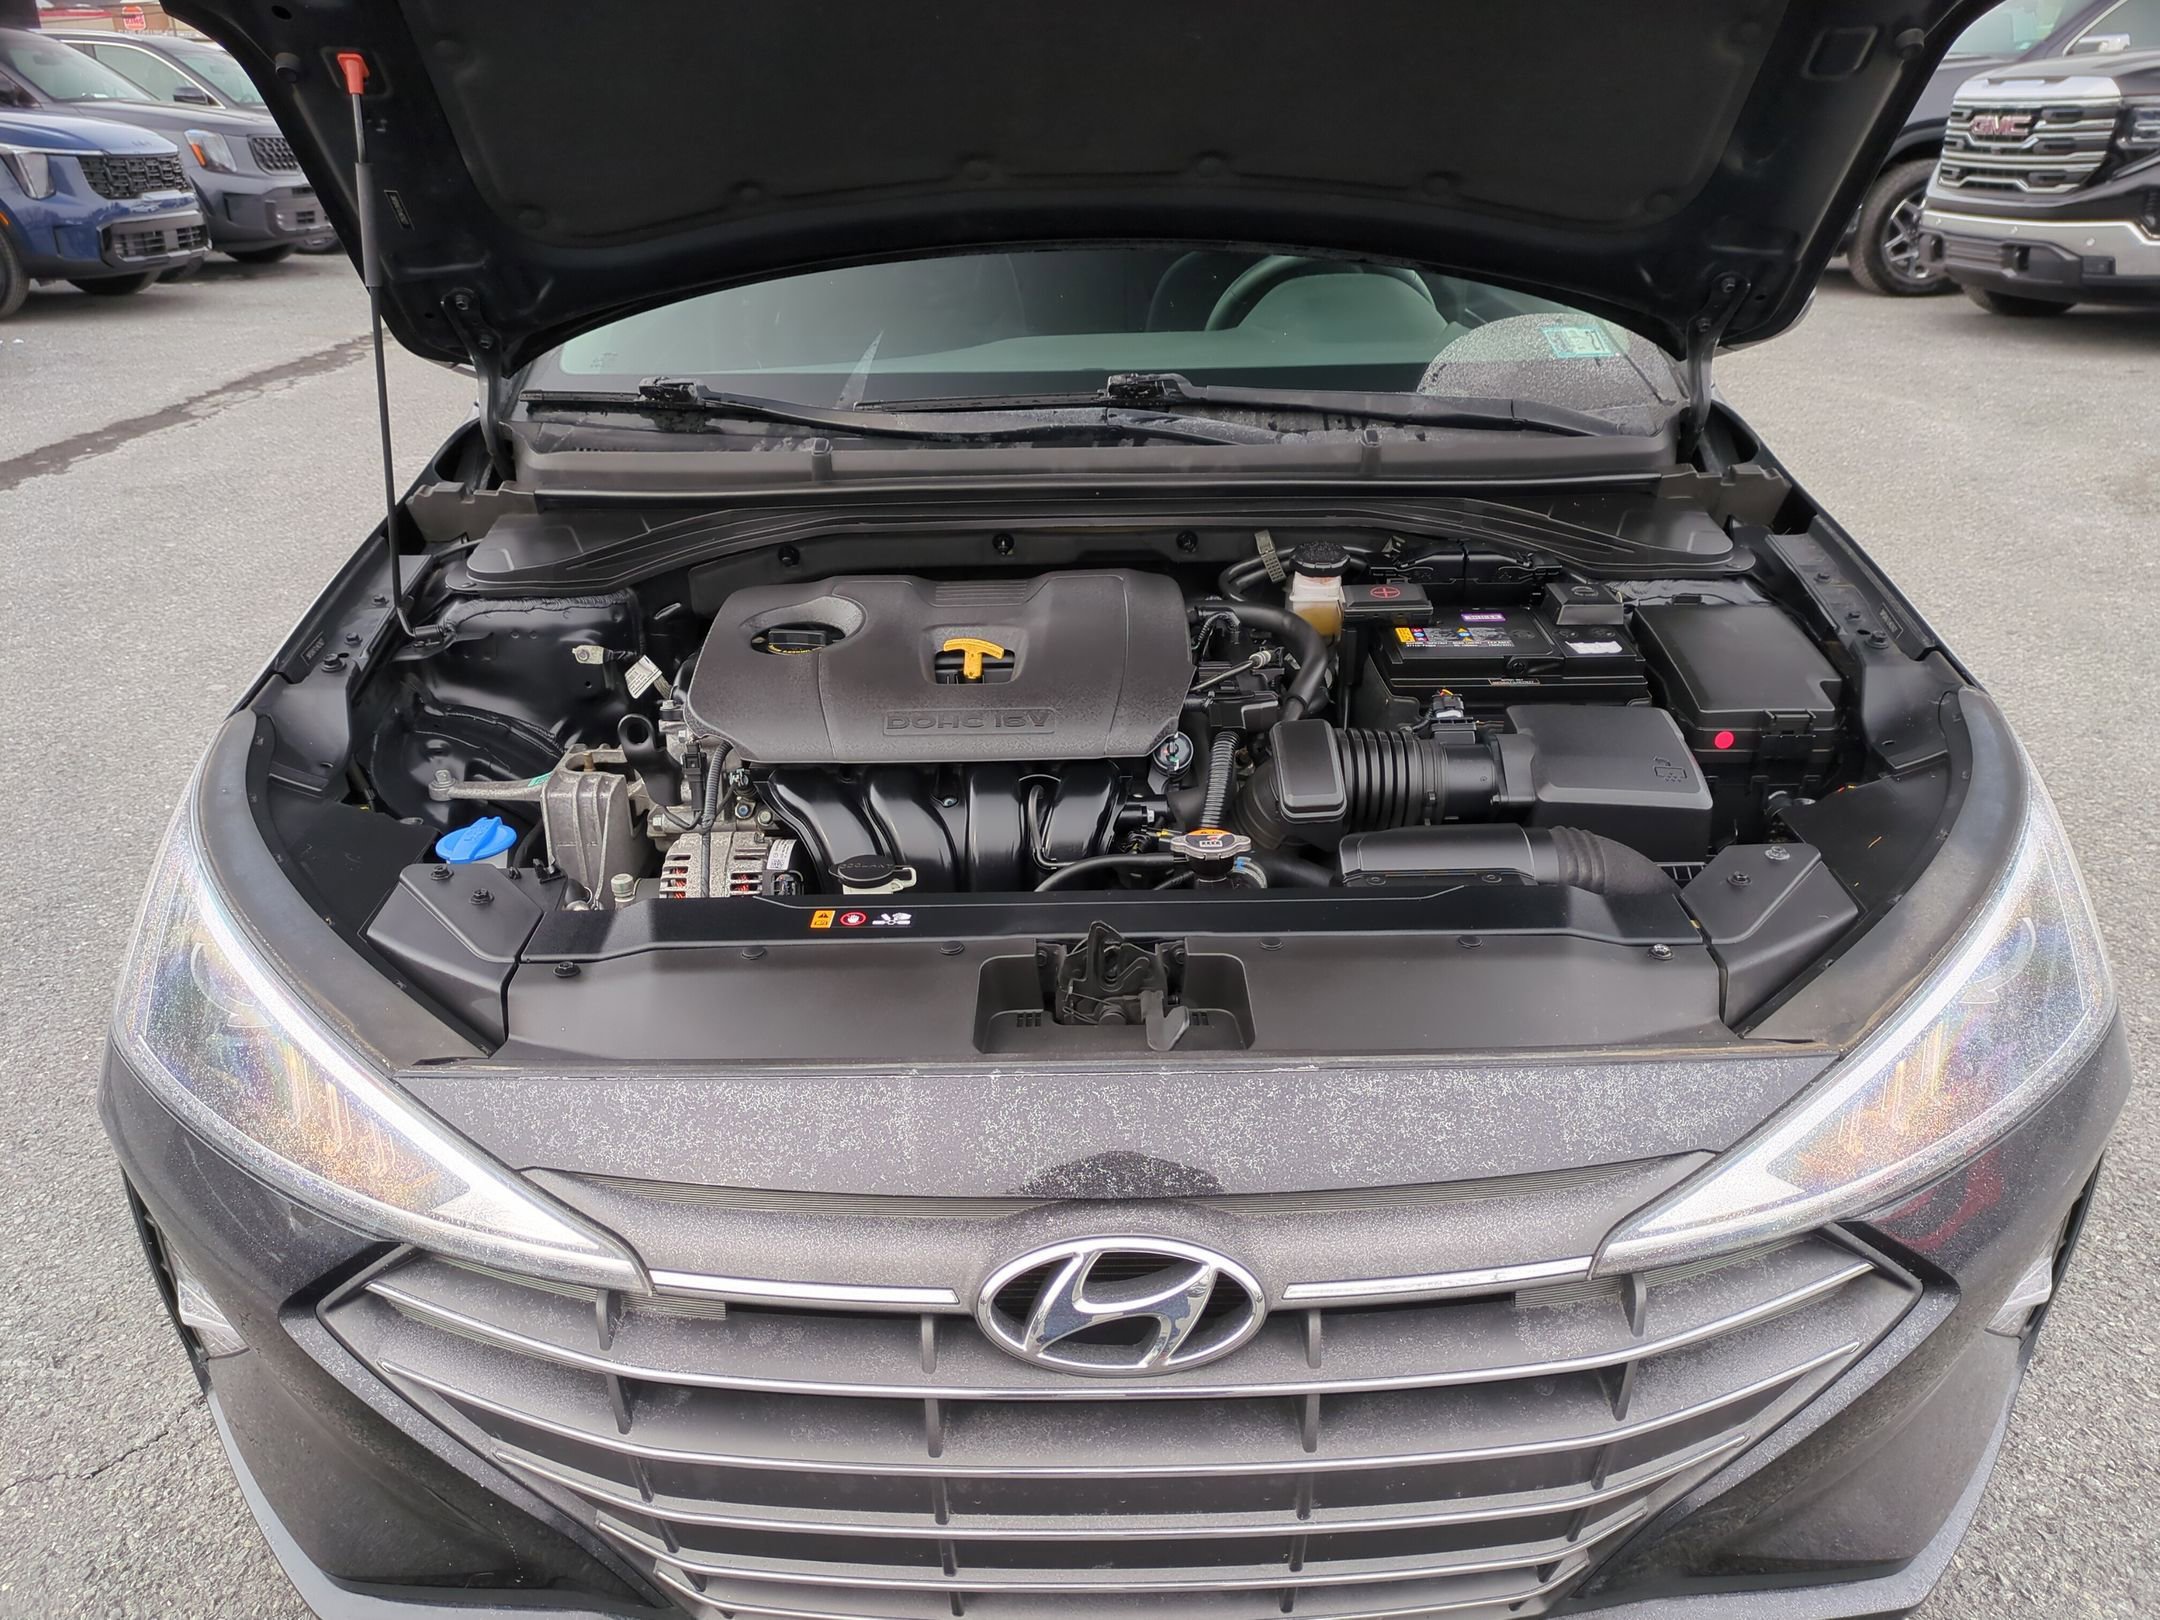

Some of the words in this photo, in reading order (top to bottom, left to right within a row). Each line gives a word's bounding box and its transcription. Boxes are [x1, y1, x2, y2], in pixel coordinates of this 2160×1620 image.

[1968, 114, 2032, 136] GMC
[885, 711, 985, 729] DOHC
[994, 709, 1050, 728] 16V
